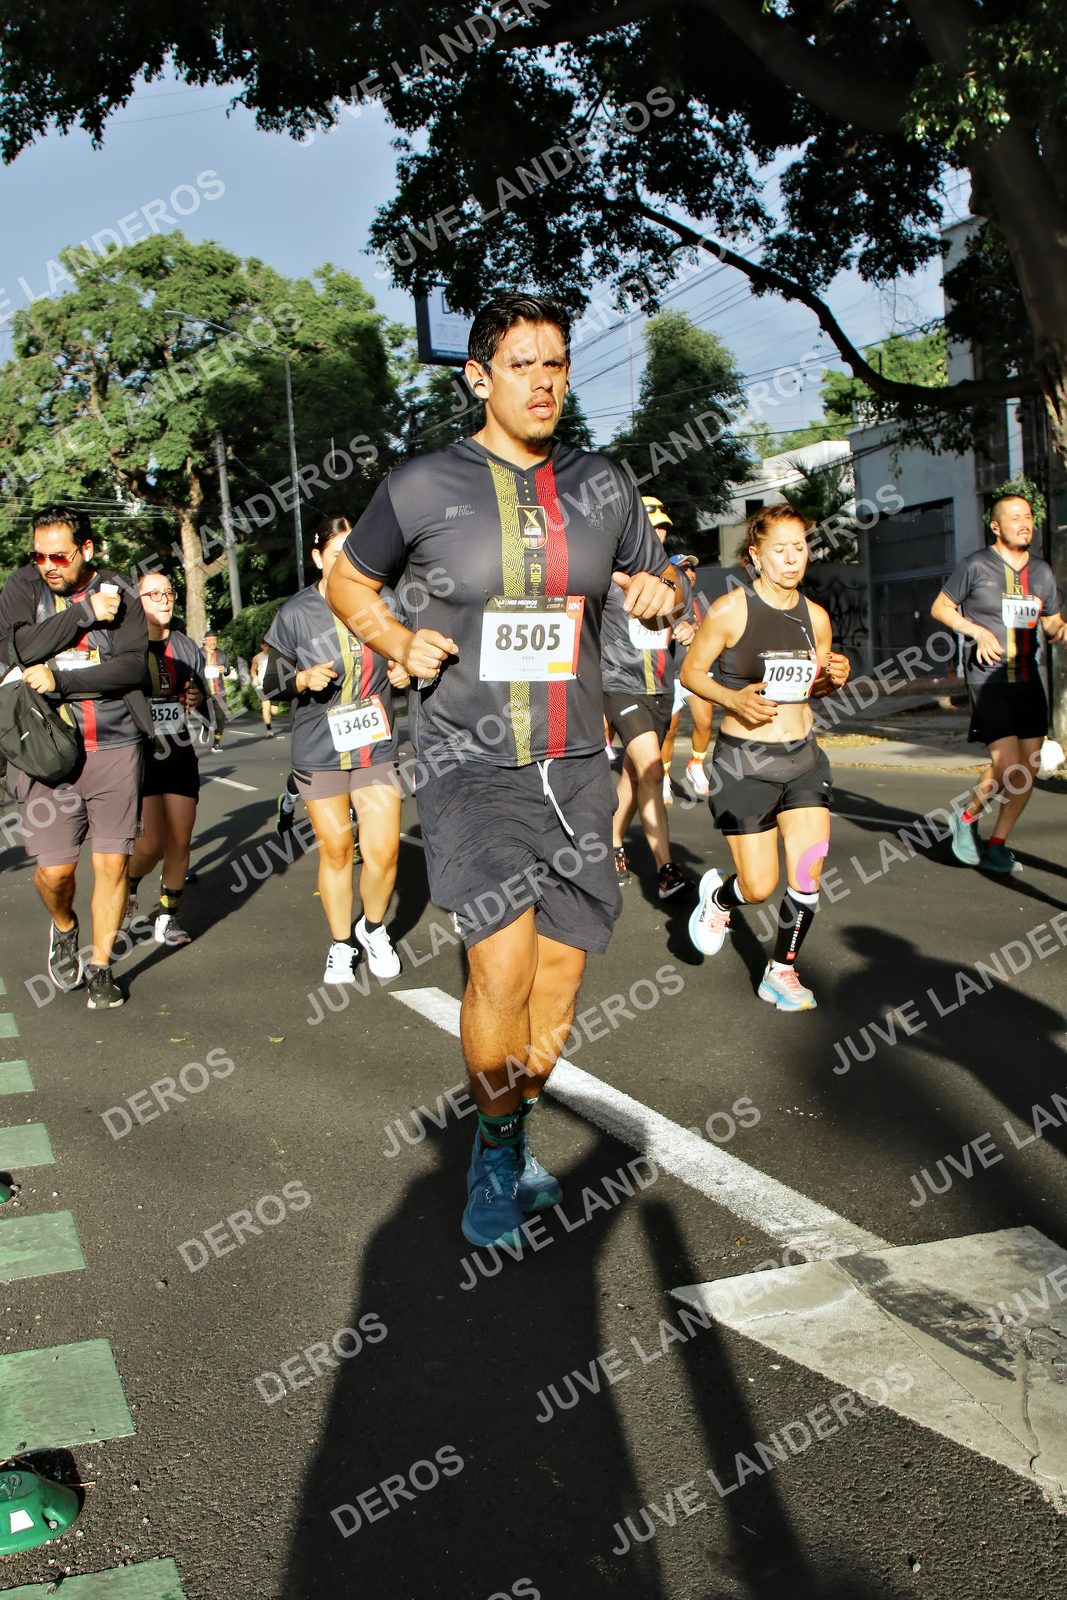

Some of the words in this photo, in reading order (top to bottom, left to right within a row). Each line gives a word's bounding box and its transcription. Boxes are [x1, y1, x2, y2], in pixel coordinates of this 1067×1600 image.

[1007, 605, 1037, 617] 13116
[495, 624, 561, 651] 8505
[769, 666, 813, 683] 10935
[334, 711, 379, 736] 13465
